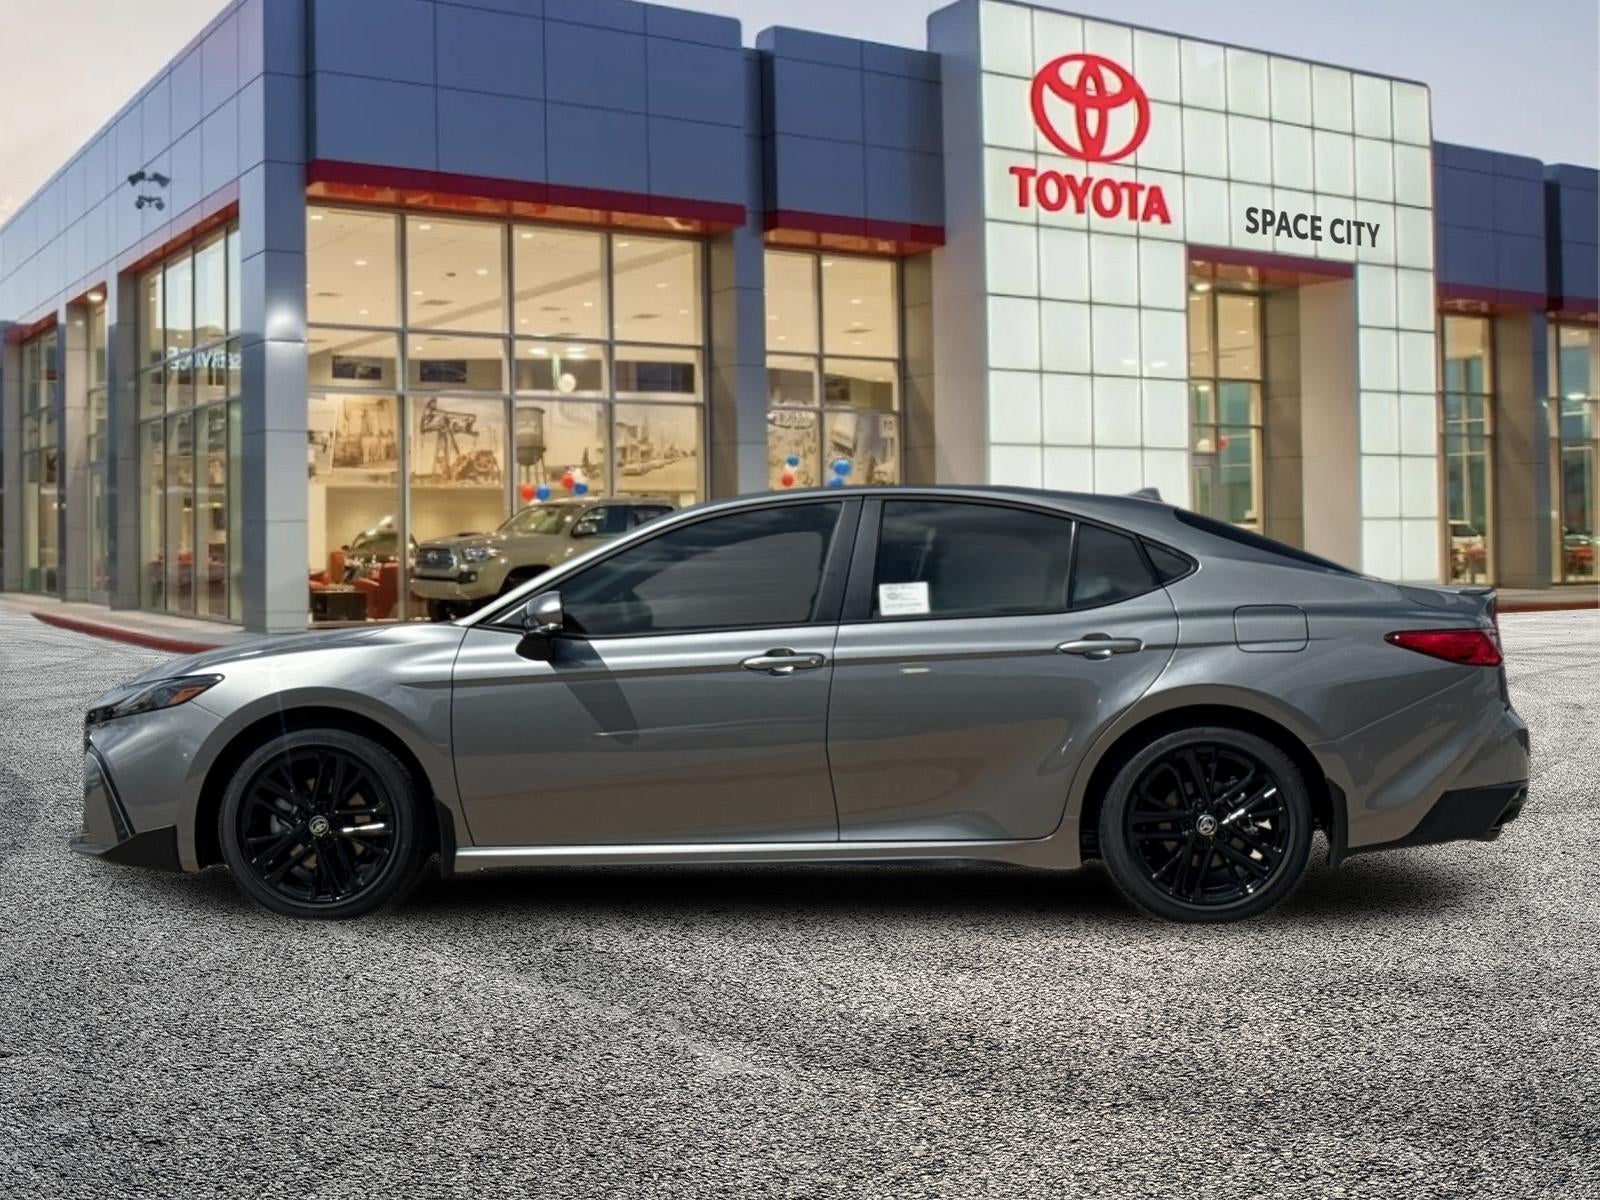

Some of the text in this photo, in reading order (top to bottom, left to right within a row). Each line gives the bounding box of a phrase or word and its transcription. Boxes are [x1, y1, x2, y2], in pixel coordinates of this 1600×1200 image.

[1009, 166, 1171, 224] TOYOTA
[1245, 206, 1380, 248] SPACE CITY
